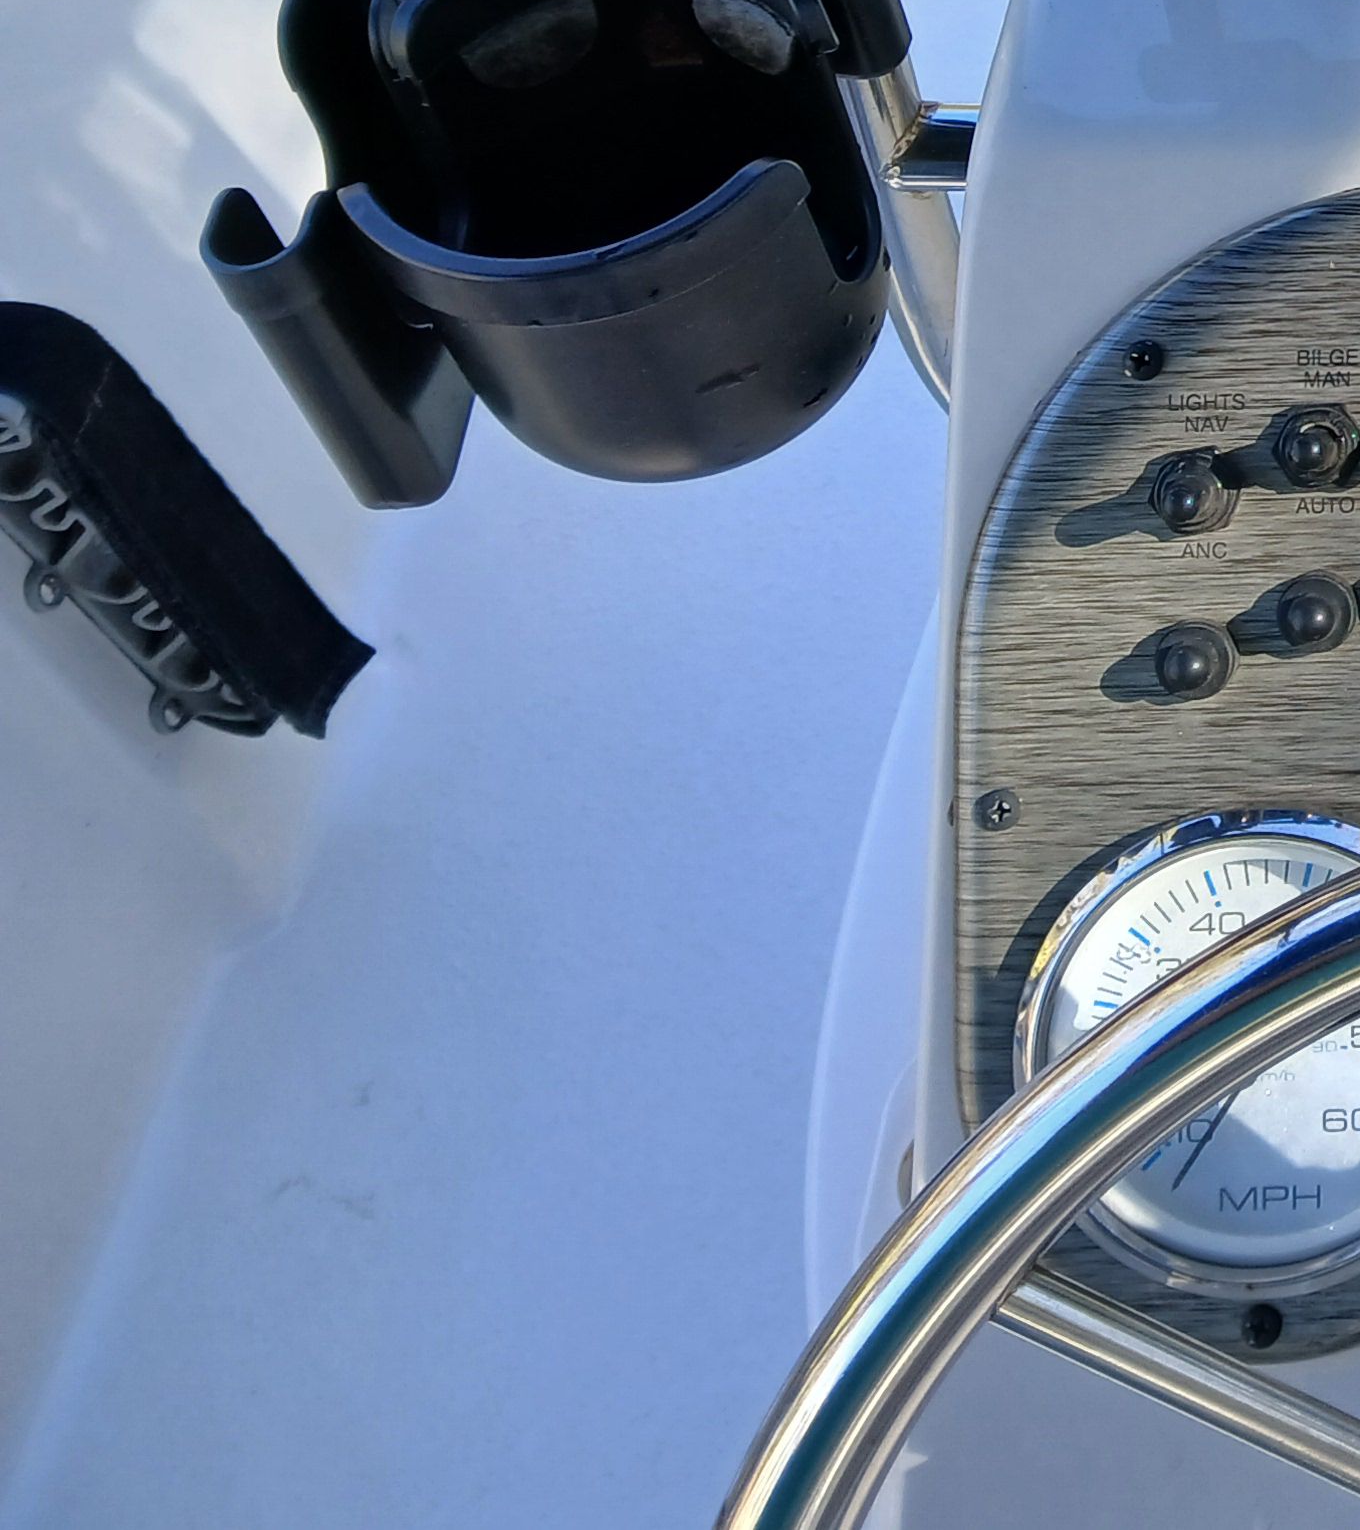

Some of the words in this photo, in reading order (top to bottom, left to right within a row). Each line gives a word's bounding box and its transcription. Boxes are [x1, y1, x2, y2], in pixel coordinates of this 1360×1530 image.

[1296, 348, 1359, 367] BILGE
[1304, 371, 1351, 388] MAN
[1168, 393, 1246, 412] LIGHTS
[1184, 415, 1228, 433] NAV
[1296, 497, 1356, 515] AUTO
[1181, 541, 1228, 560] ANC
[1189, 911, 1246, 935] 40
[1219, 1185, 1322, 1212] MPH
